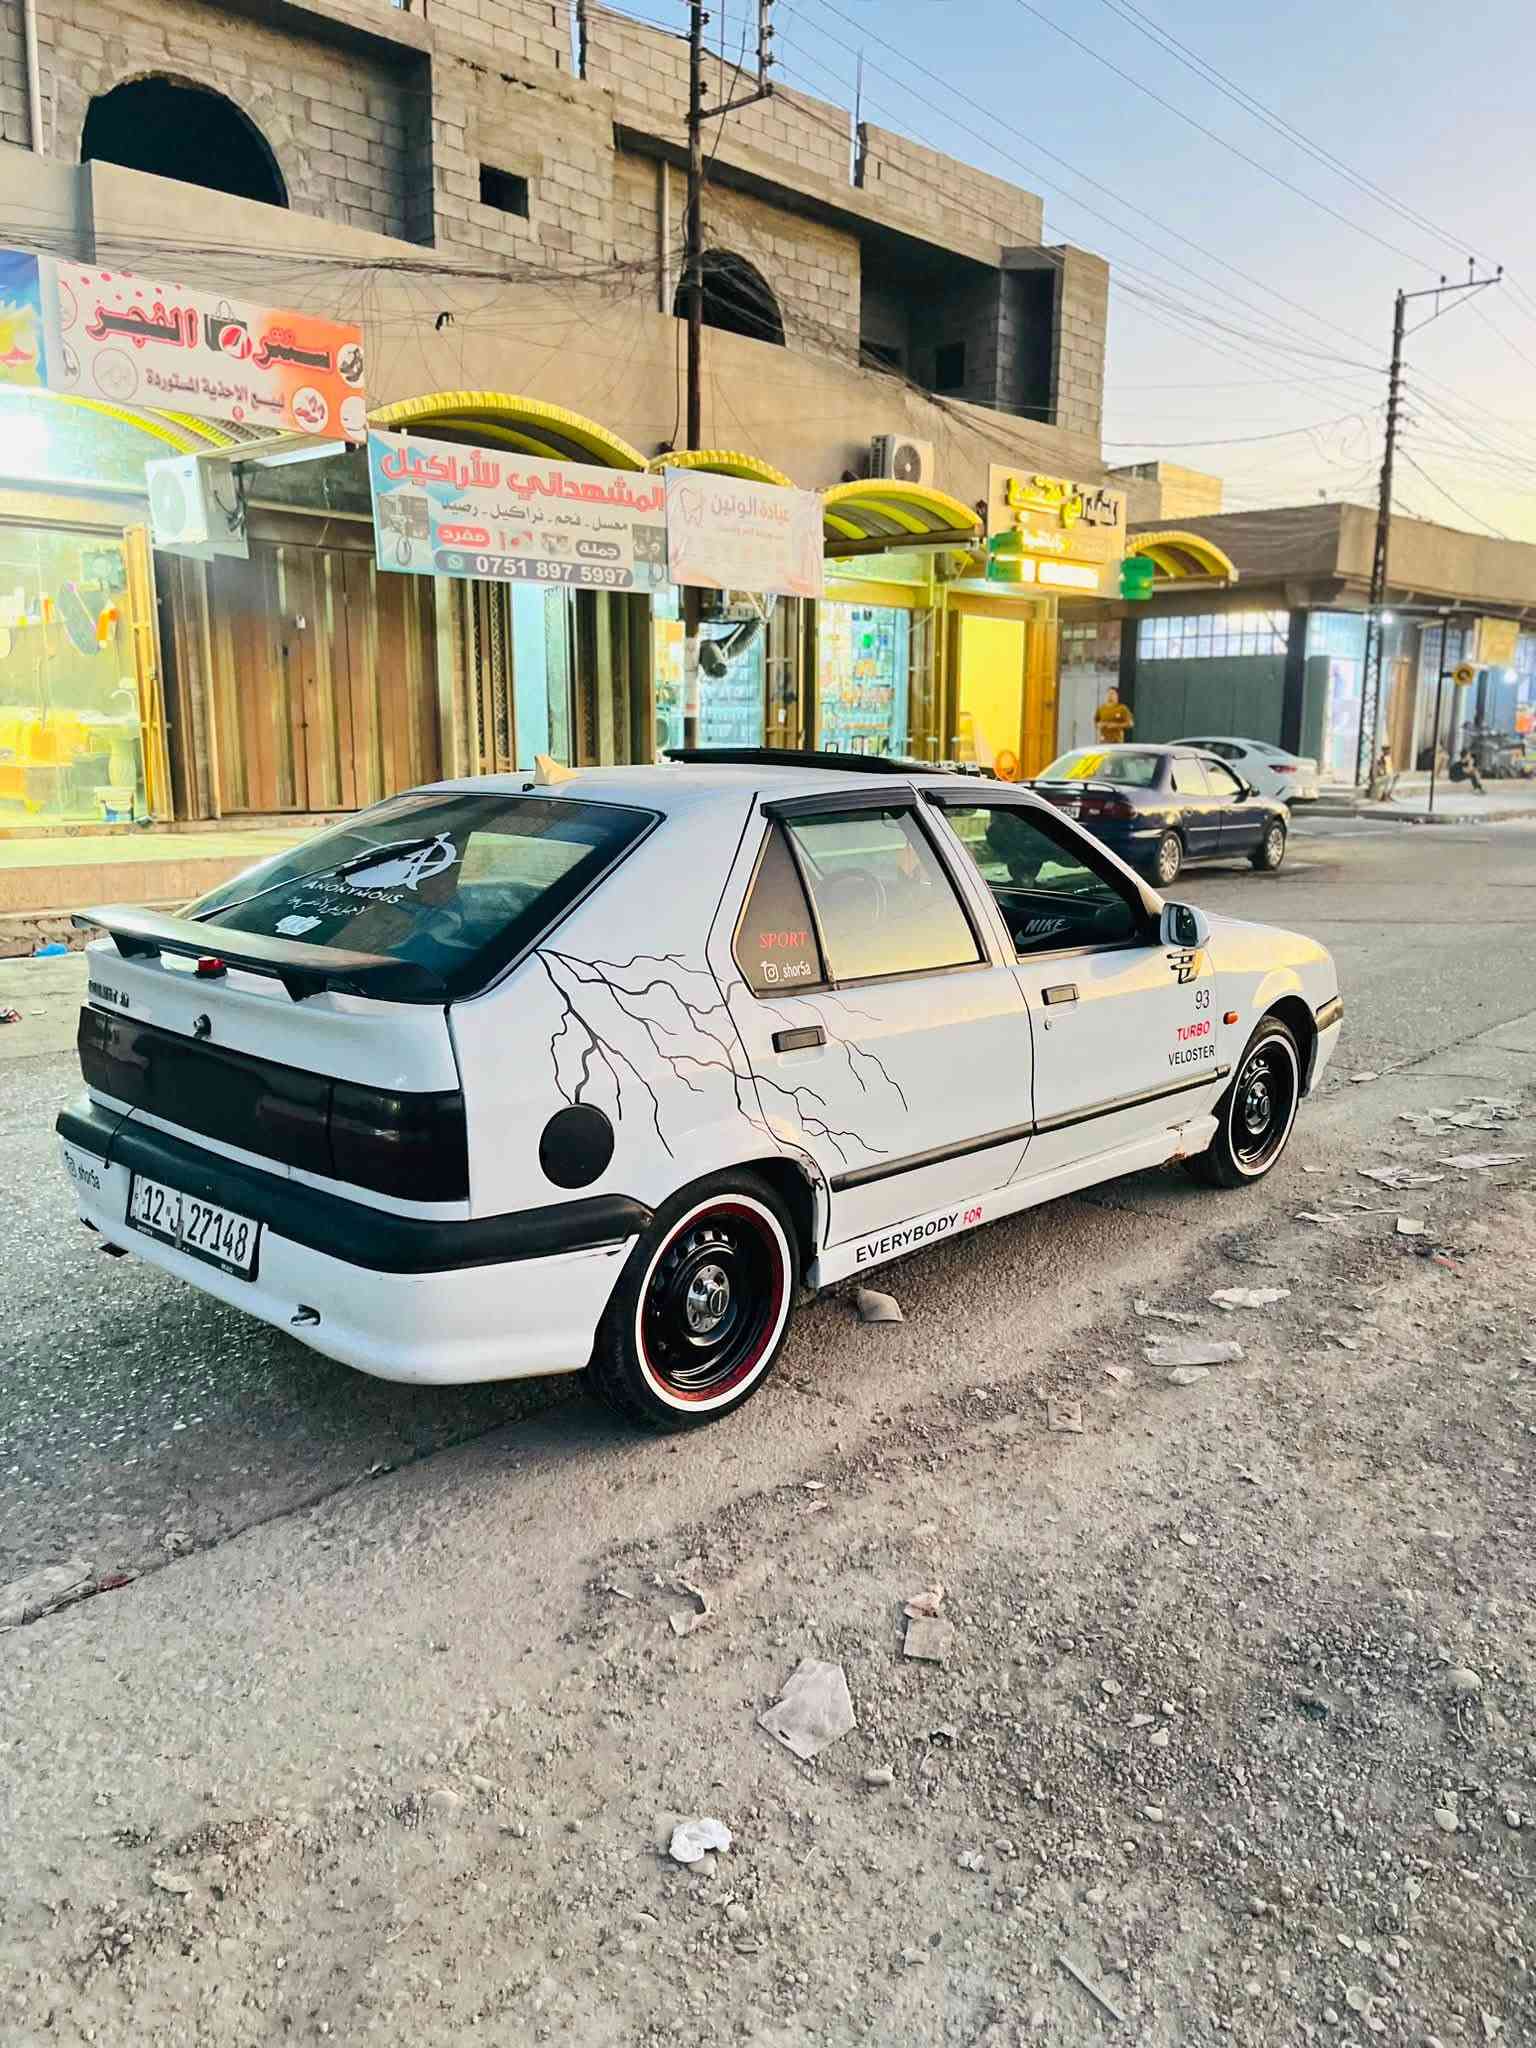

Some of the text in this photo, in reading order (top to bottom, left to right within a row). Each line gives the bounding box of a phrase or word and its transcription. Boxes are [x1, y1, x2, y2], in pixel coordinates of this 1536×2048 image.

[86, 302, 198, 348] الفجر
[506, 470, 666, 512] المشهداني
[476, 558, 628, 585] 0751 897 5997
[303, 878, 404, 904] ANONYMOUS
[1025, 918, 1066, 933] NIKE
[760, 931, 809, 951] SPORT
[1195, 989, 1210, 1010] 93
[1176, 1020, 1210, 1041] TURBO
[1168, 1045, 1215, 1066] VELOSTER
[142, 1185, 165, 1226] 12
[187, 1203, 249, 1262] 27148
[856, 1206, 983, 1264] EVERYBODY FOR
